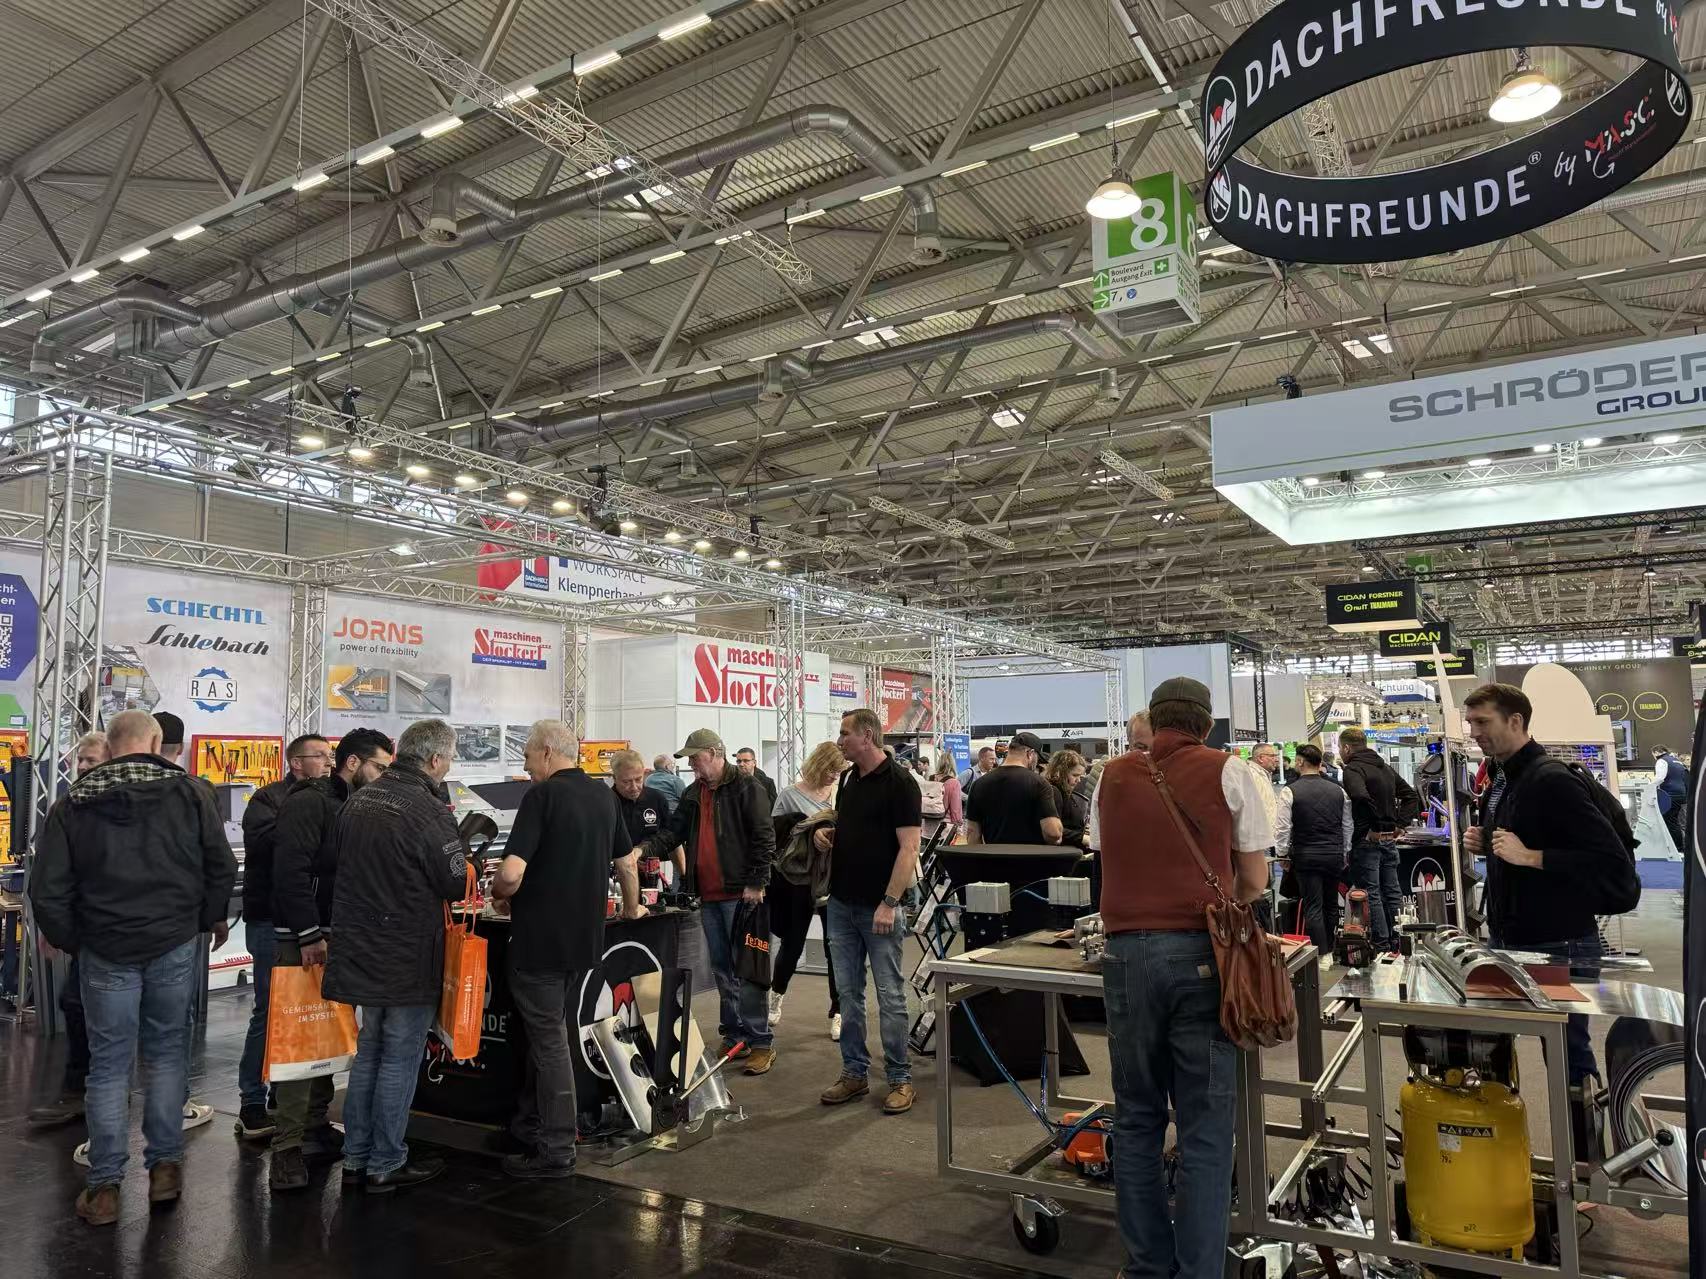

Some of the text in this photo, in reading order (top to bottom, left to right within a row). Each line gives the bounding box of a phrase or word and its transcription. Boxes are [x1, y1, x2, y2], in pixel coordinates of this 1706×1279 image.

[1245, 0, 1638, 107] DACHFR
[1554, 151, 1577, 186] by
[1130, 197, 1168, 251] 8
[1110, 263, 1145, 277] Boulevard
[1110, 269, 1153, 285] Ausgang Exit
[1596, 386, 1706, 416] GROU
[1337, 590, 1404, 601] CIDAN FORSTNER
[146, 596, 268, 626] SCHECHTL
[138, 623, 270, 656] Schlebach
[333, 616, 424, 645] JORNS
[474, 627, 543, 661] Stockert
[493, 630, 542, 644] maschinen
[1388, 631, 1441, 644] CIDAN
[340, 643, 419, 658] power of flexibility
[1475, 643, 1486, 655] 8
[694, 642, 805, 710] Stocket
